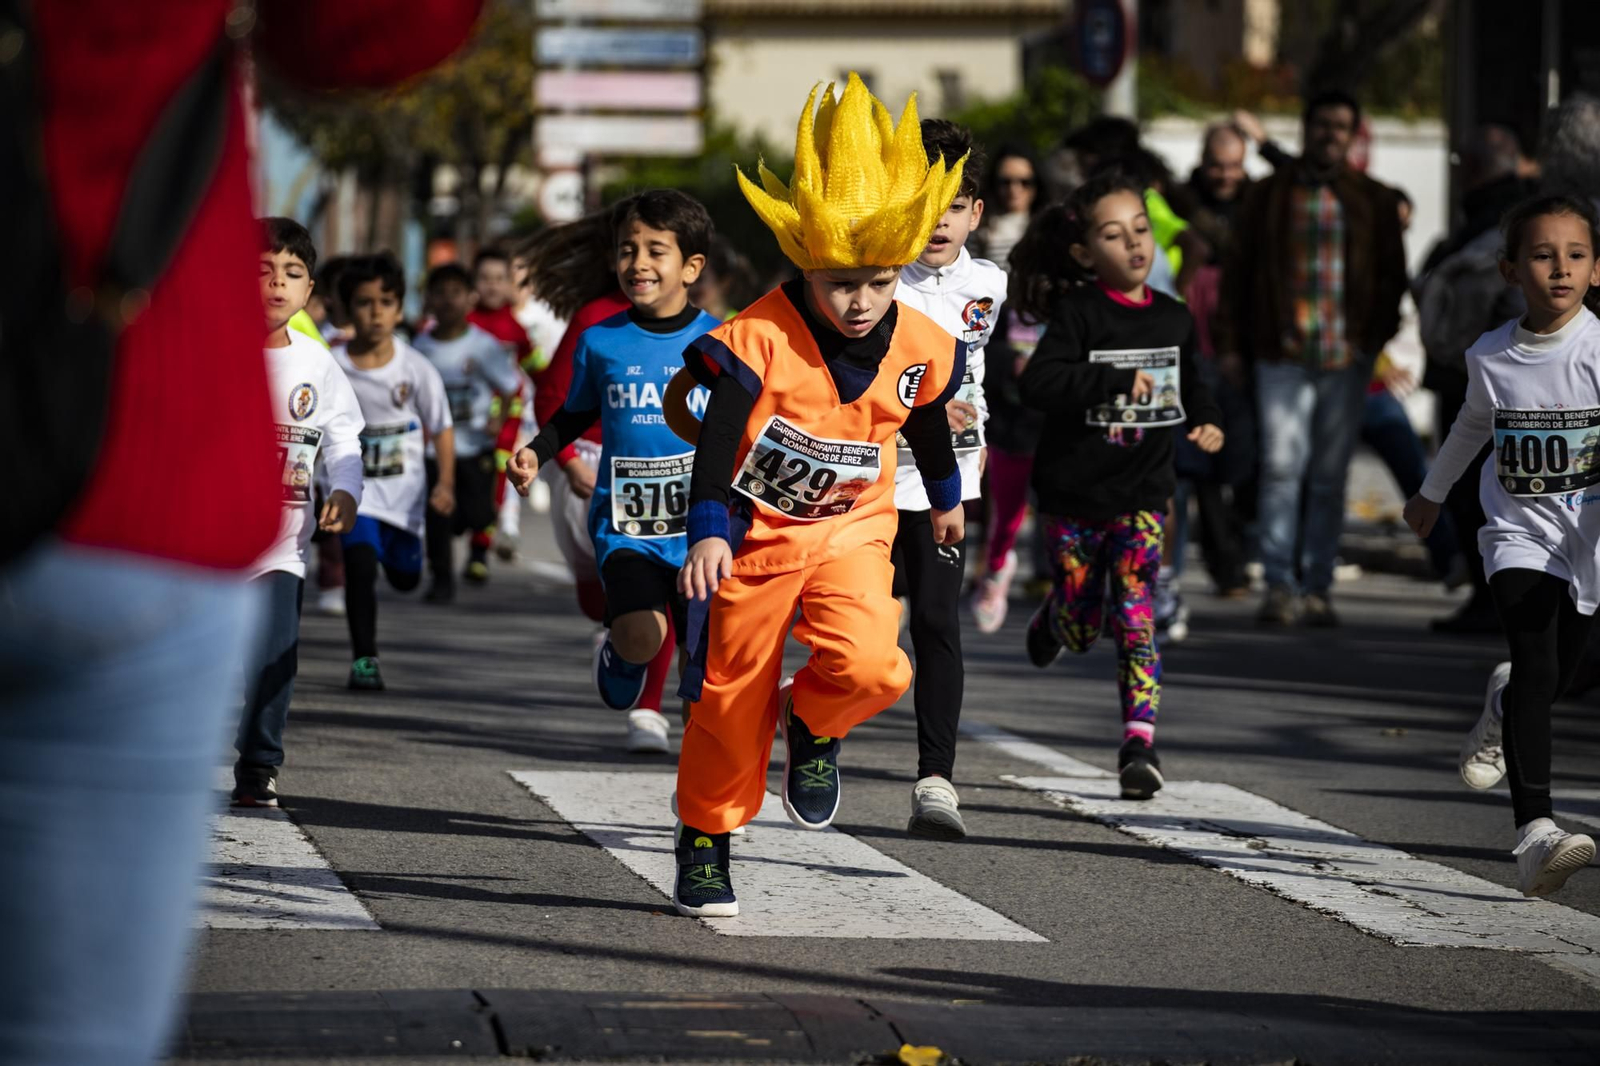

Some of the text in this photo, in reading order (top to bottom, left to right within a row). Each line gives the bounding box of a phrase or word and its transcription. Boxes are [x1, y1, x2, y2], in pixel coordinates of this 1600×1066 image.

[626, 365, 644, 376] JRZ.
[1496, 411, 1527, 420] CARRERA
[1508, 420, 1589, 429] BOMBEROS DE JEREZ
[772, 420, 877, 457] CARRERA INFANTIL BENÉFICA
[781, 437, 862, 465] BOMBEROS DE JEREZ
[1500, 434, 1569, 475] 400
[615, 461, 648, 469] CARRERA
[648, 460, 682, 468] INFANTIL
[628, 468, 672, 477] BOMBEROS
[672, 466, 683, 474] DE
[755, 448, 838, 503] 429
[622, 480, 687, 518] 376
